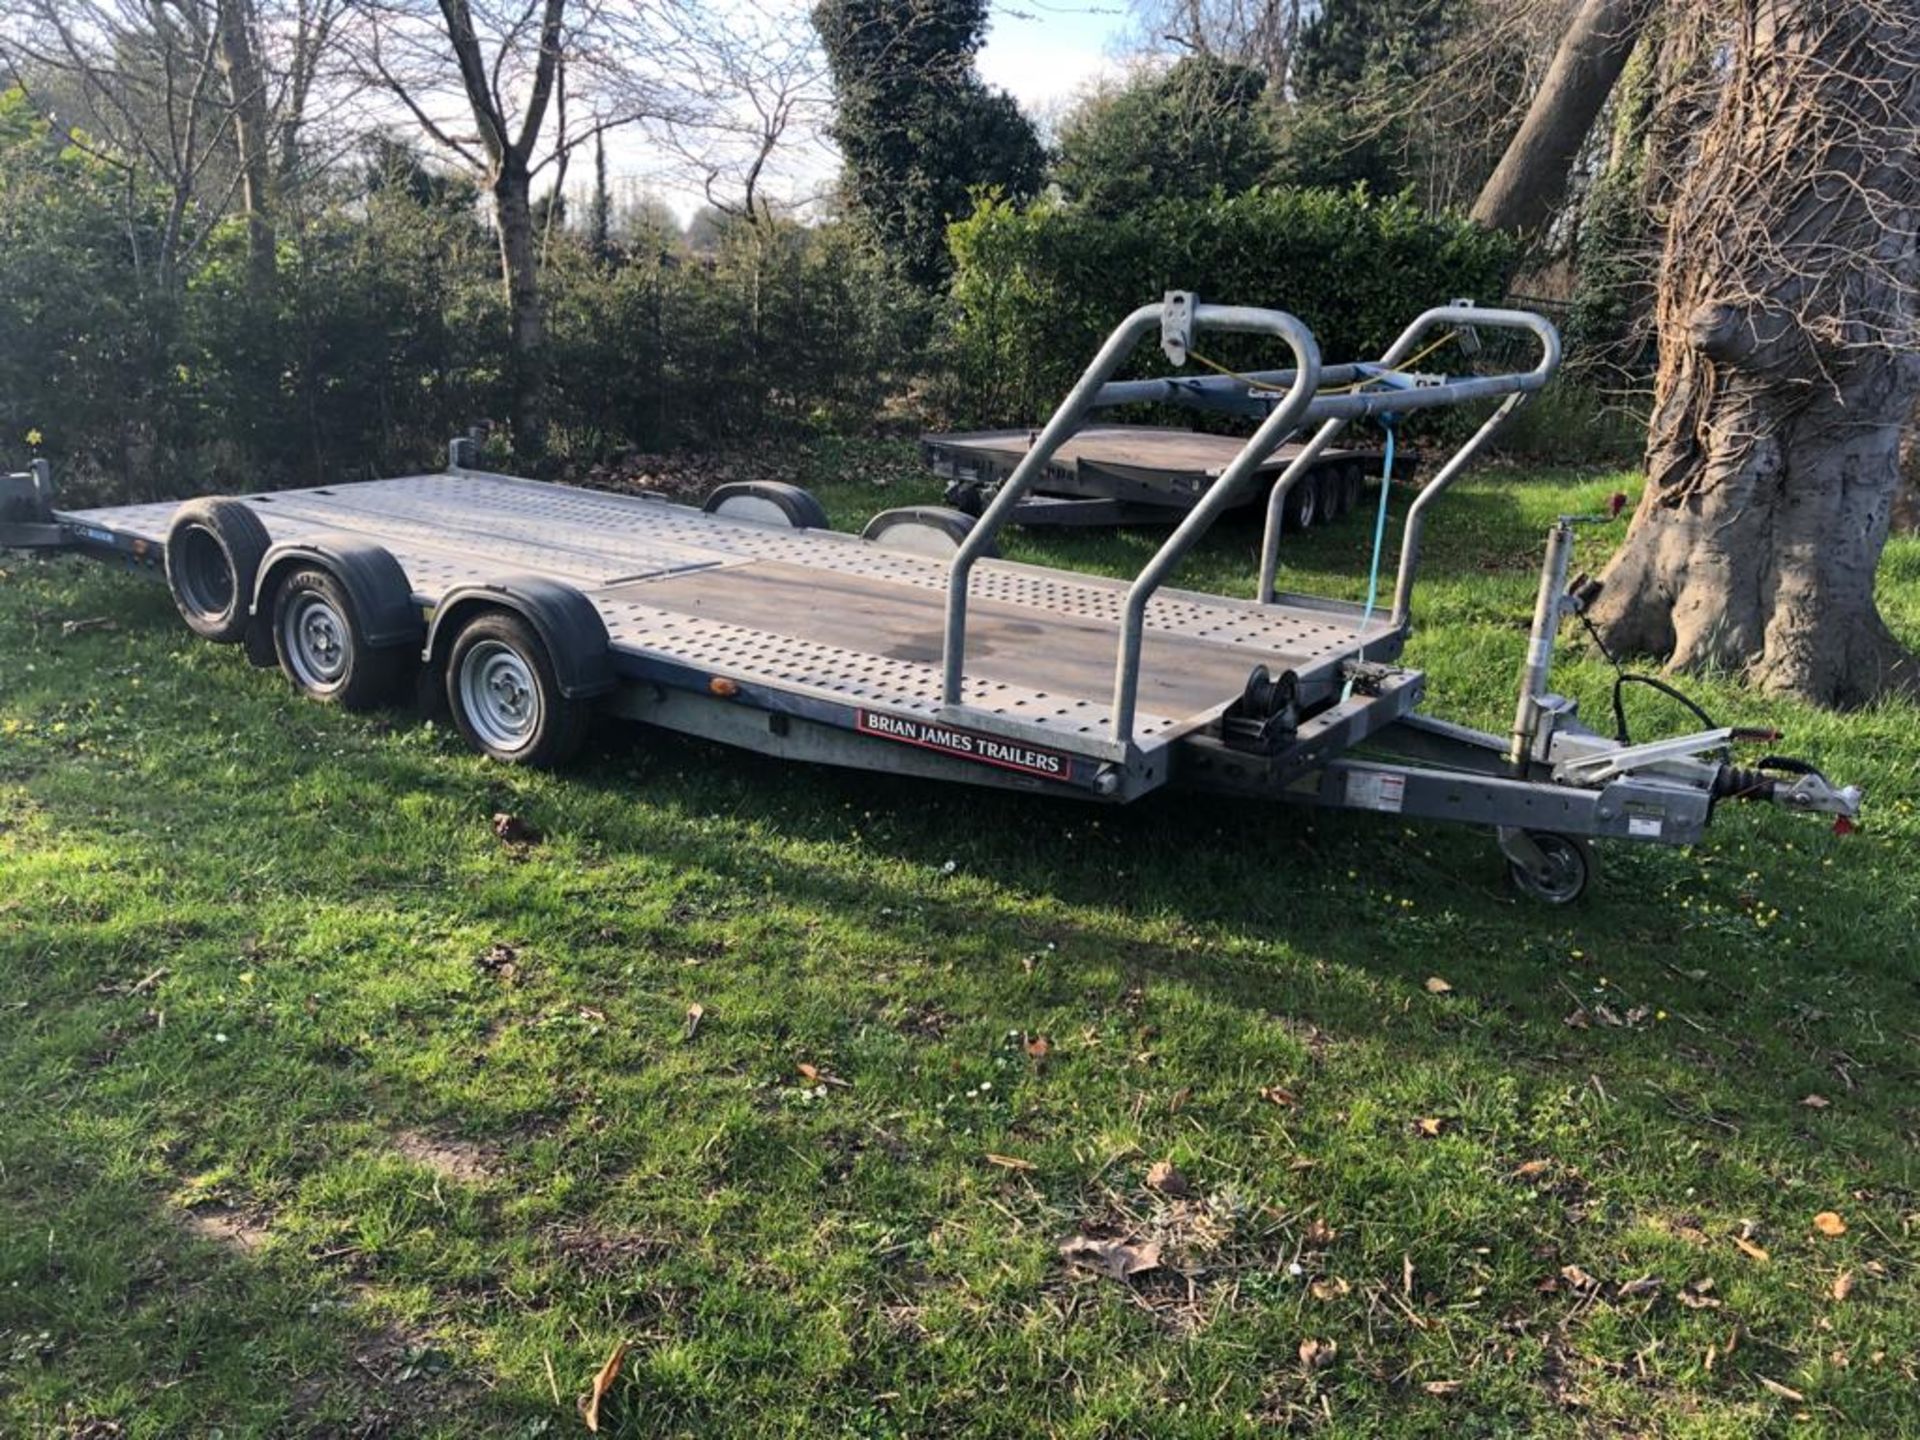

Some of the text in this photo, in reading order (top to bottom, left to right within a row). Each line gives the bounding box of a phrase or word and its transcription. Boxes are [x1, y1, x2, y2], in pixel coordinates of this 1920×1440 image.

[868, 713, 1059, 772] BRIAN JAMES TRAILERS
